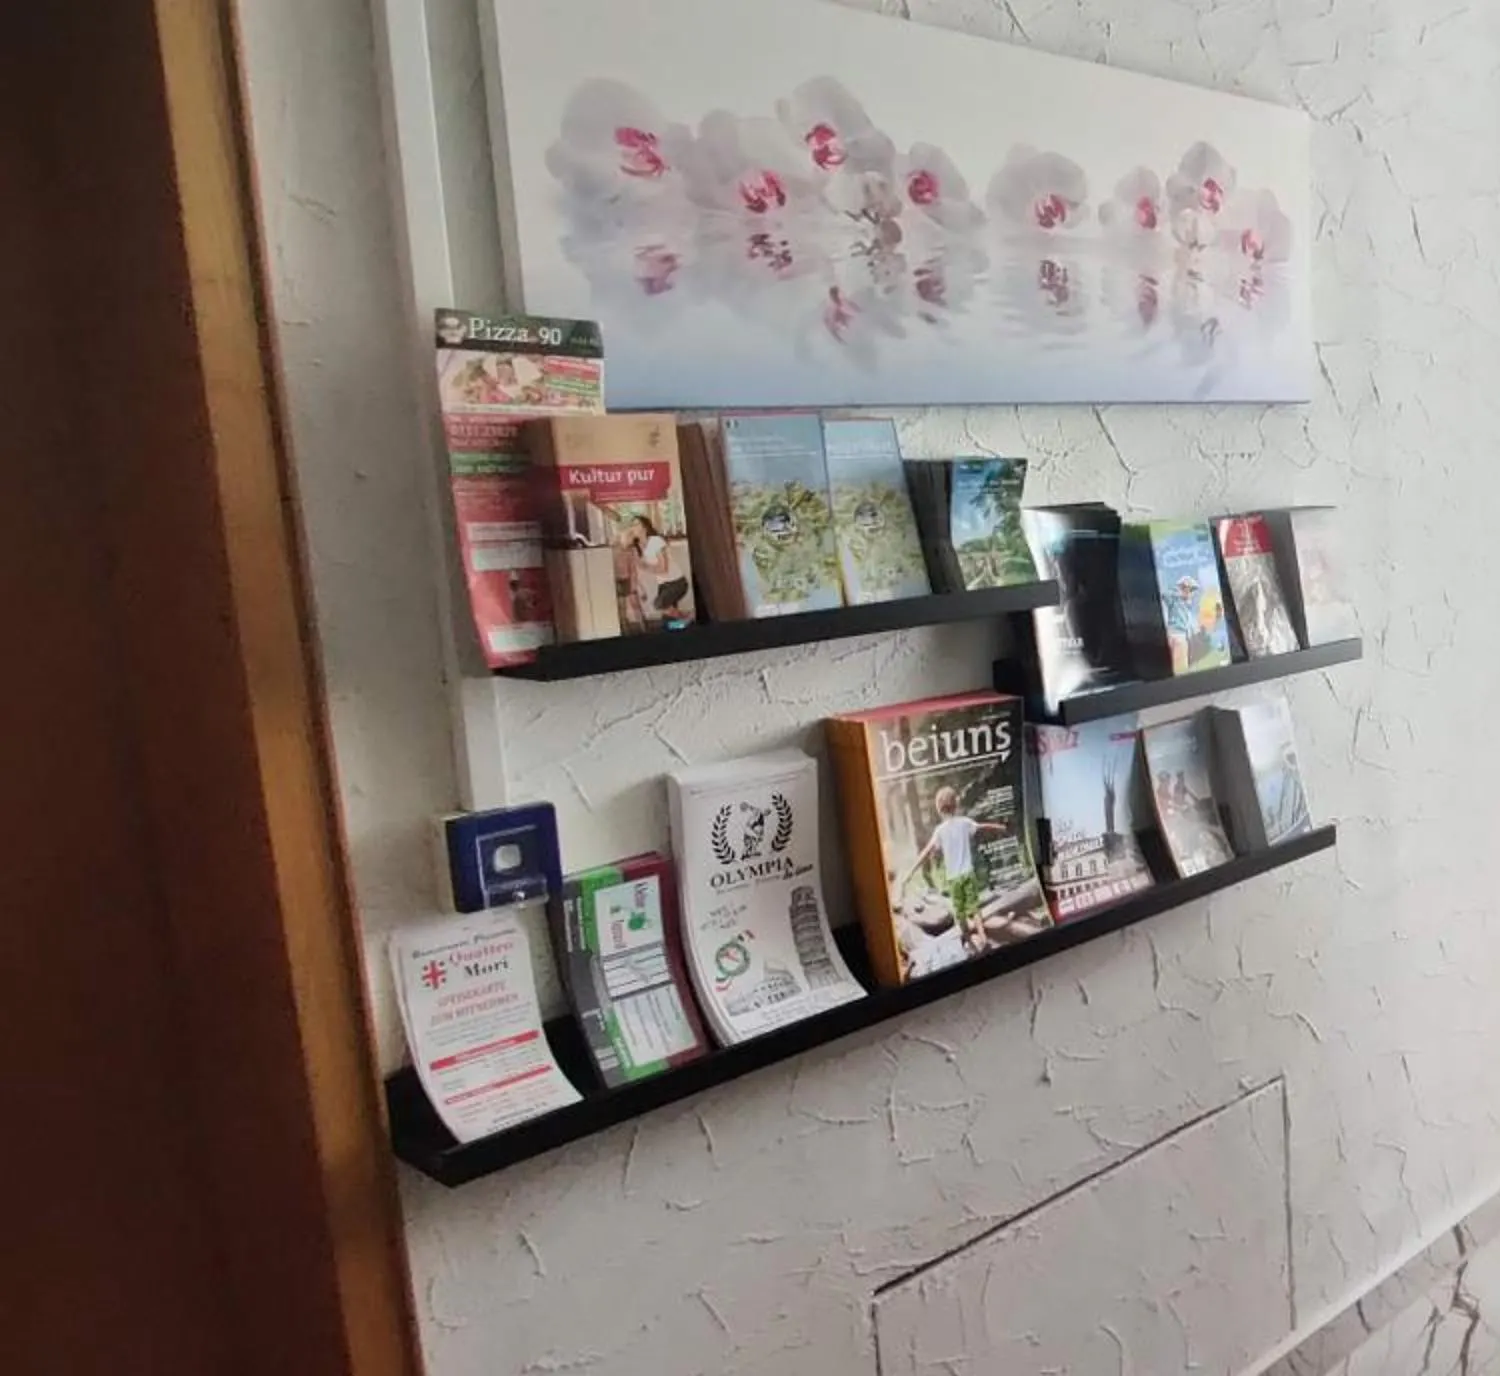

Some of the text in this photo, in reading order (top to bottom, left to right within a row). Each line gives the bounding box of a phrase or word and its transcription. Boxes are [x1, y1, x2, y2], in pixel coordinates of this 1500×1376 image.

[468, 317, 529, 343] Pizza
[538, 327, 562, 346] 90
[569, 466, 655, 488] Kultur pur
[710, 856, 793, 889] OLYMPIA
[448, 940, 517, 968] Quattro
[463, 956, 509, 977] Mori
